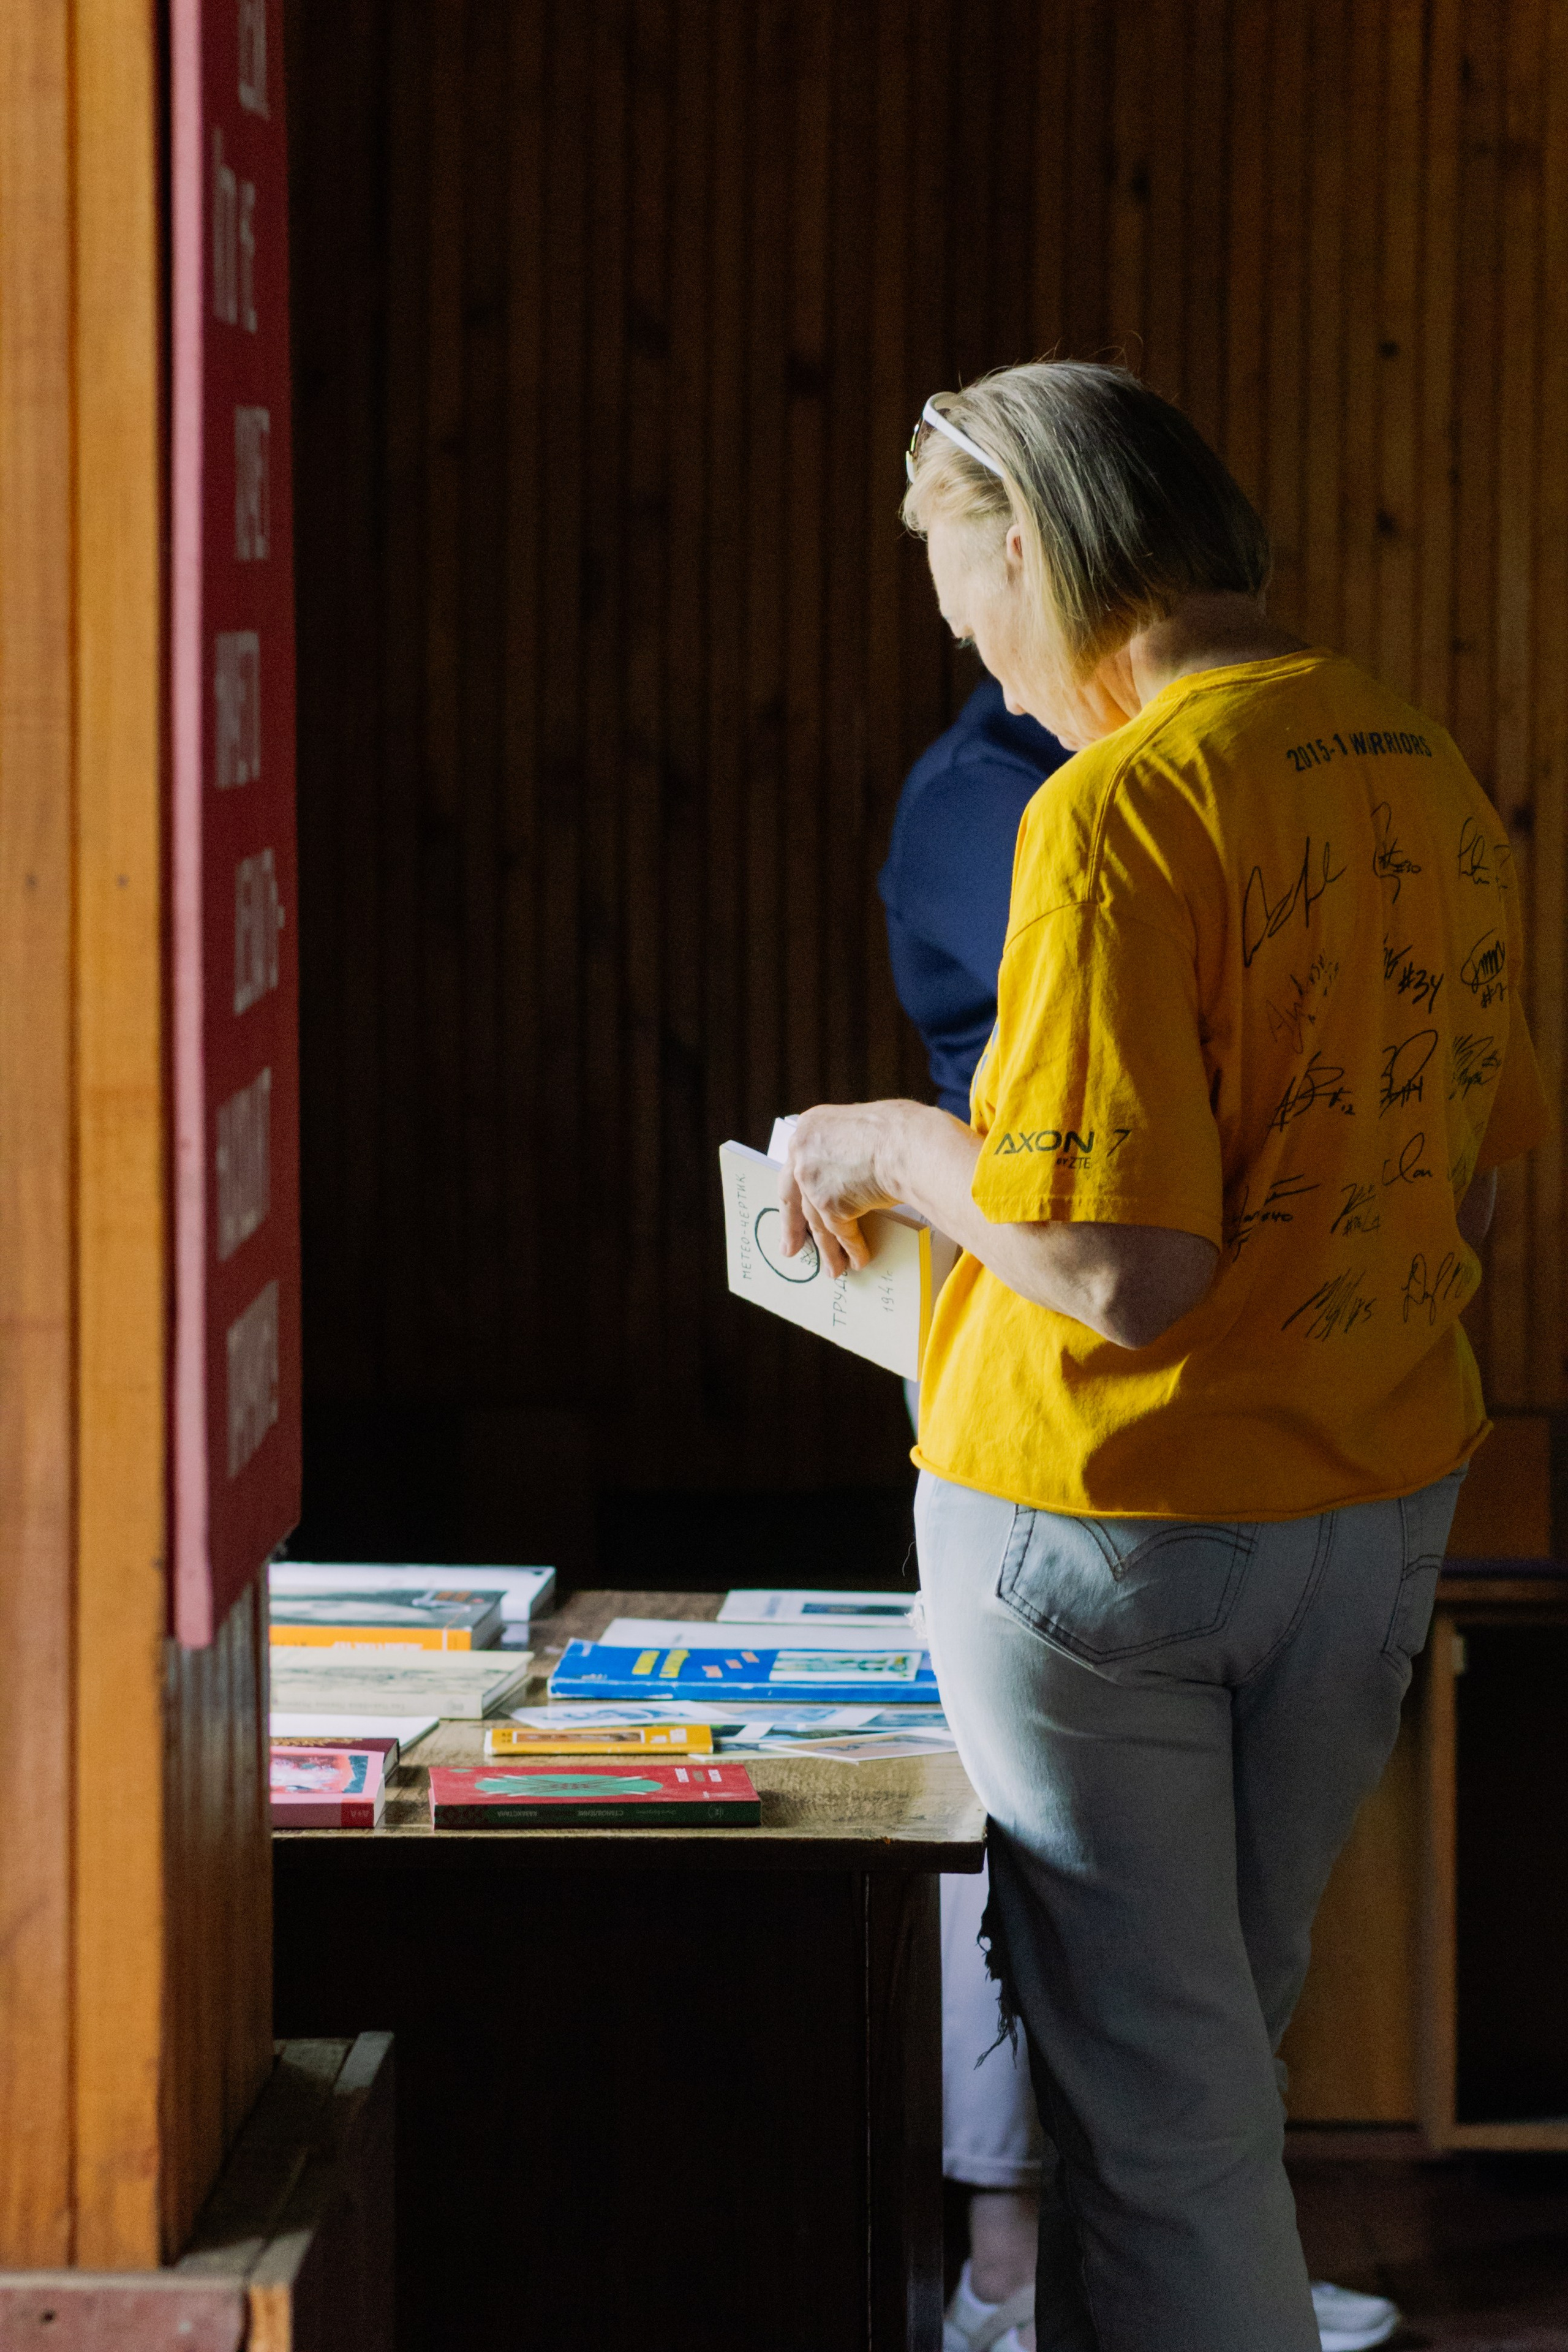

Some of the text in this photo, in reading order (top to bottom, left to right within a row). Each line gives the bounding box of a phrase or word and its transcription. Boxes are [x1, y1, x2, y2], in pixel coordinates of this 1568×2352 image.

[1349, 731, 1432, 758] WRRIORS
[993, 1129, 1132, 1158] AXON 7
[1068, 1156, 1091, 1169] ZTE
